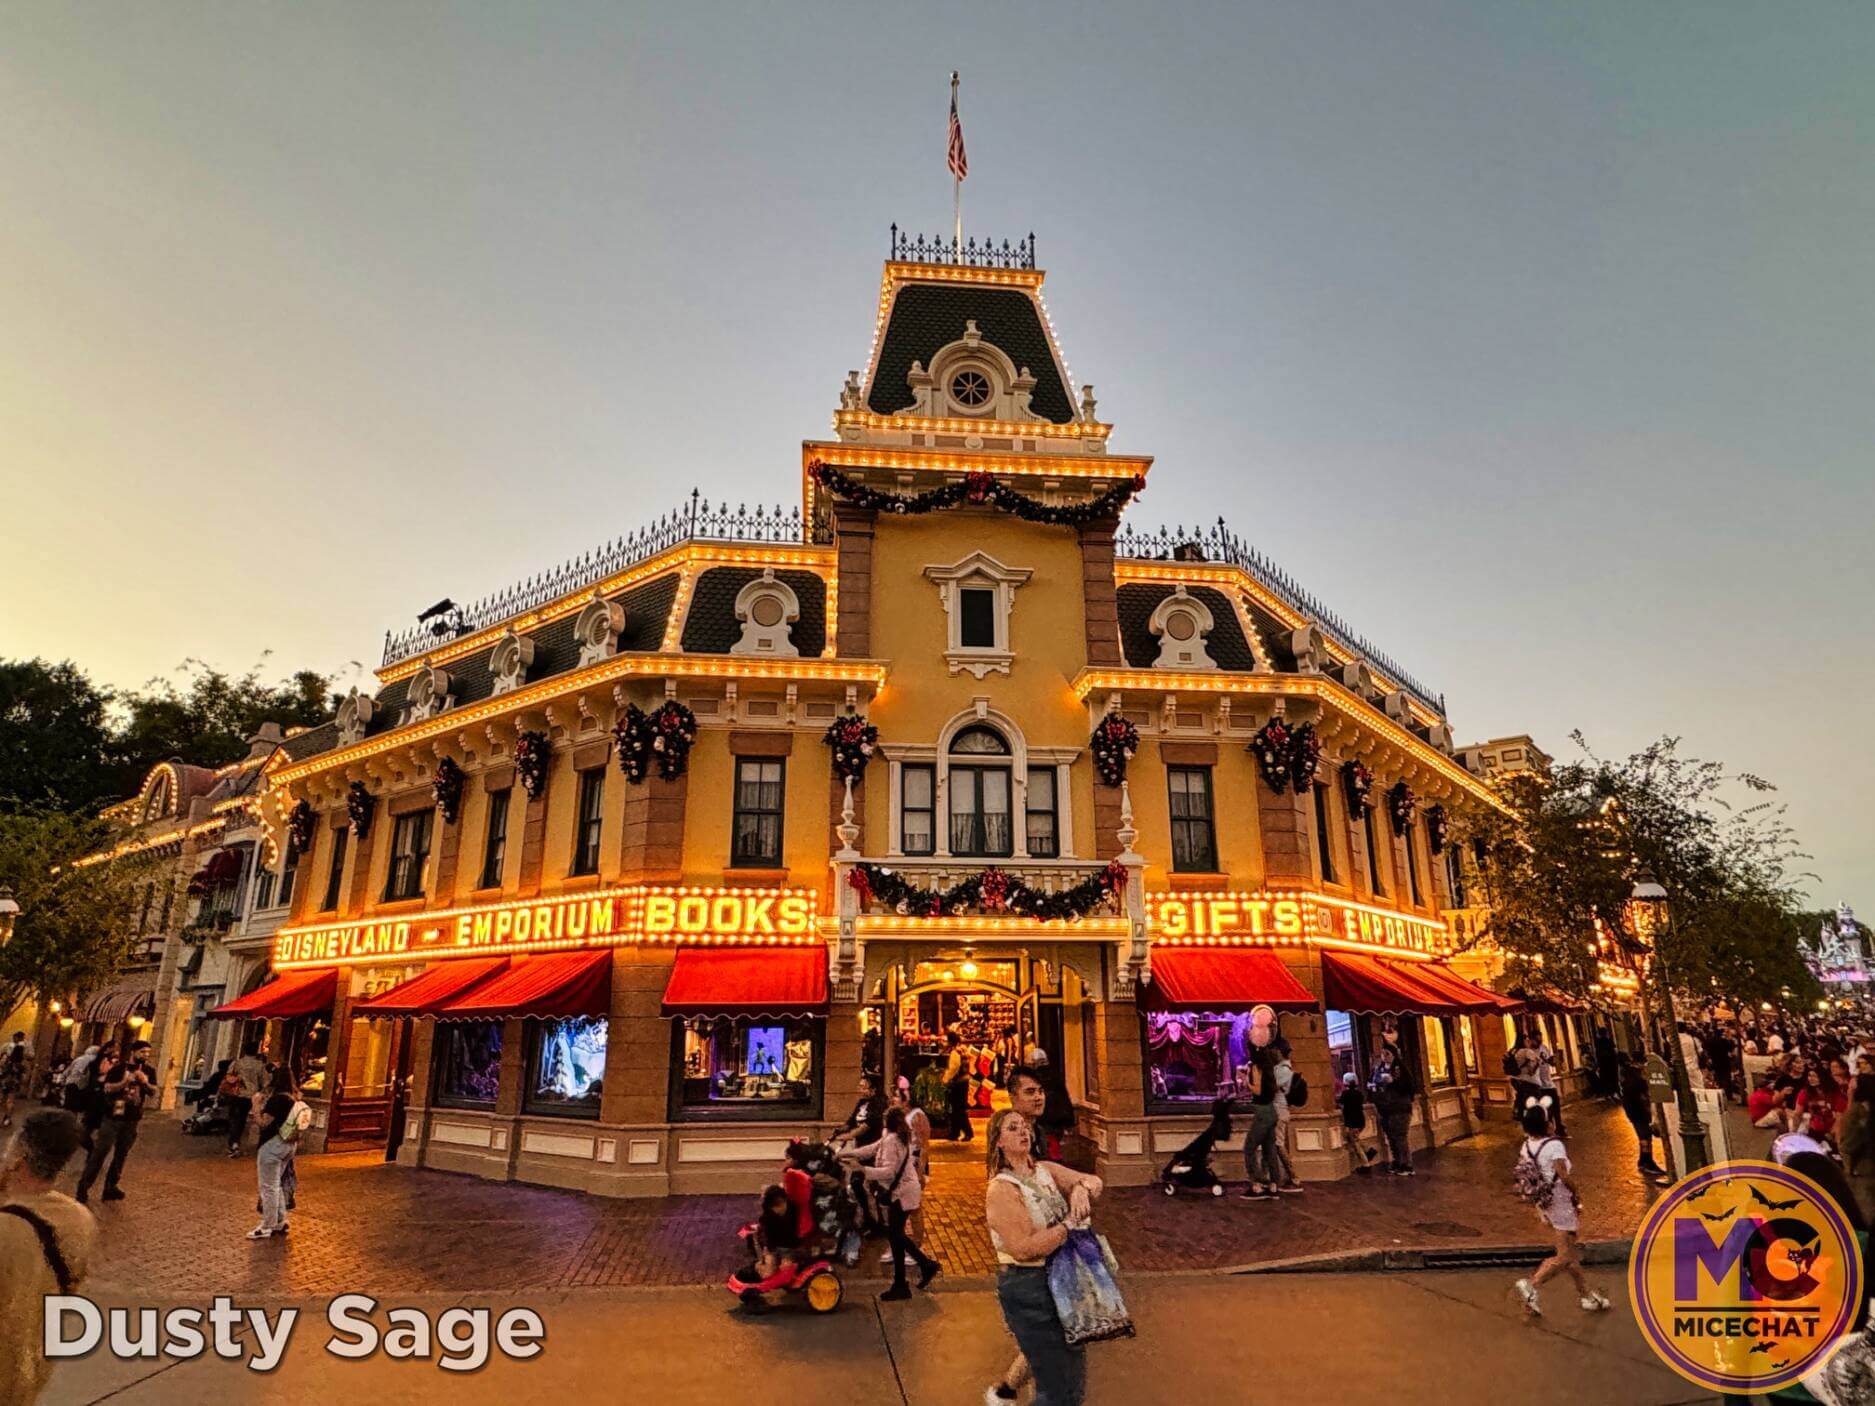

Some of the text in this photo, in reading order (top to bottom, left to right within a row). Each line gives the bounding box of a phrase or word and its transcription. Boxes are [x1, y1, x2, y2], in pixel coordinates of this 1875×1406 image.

[281, 898, 614, 961] DISNEYLAND EMPORIUM
[646, 896, 808, 934] BOOKS
[1160, 900, 1300, 936] GIFTS
[1343, 908, 1435, 952] EMPORIUM
